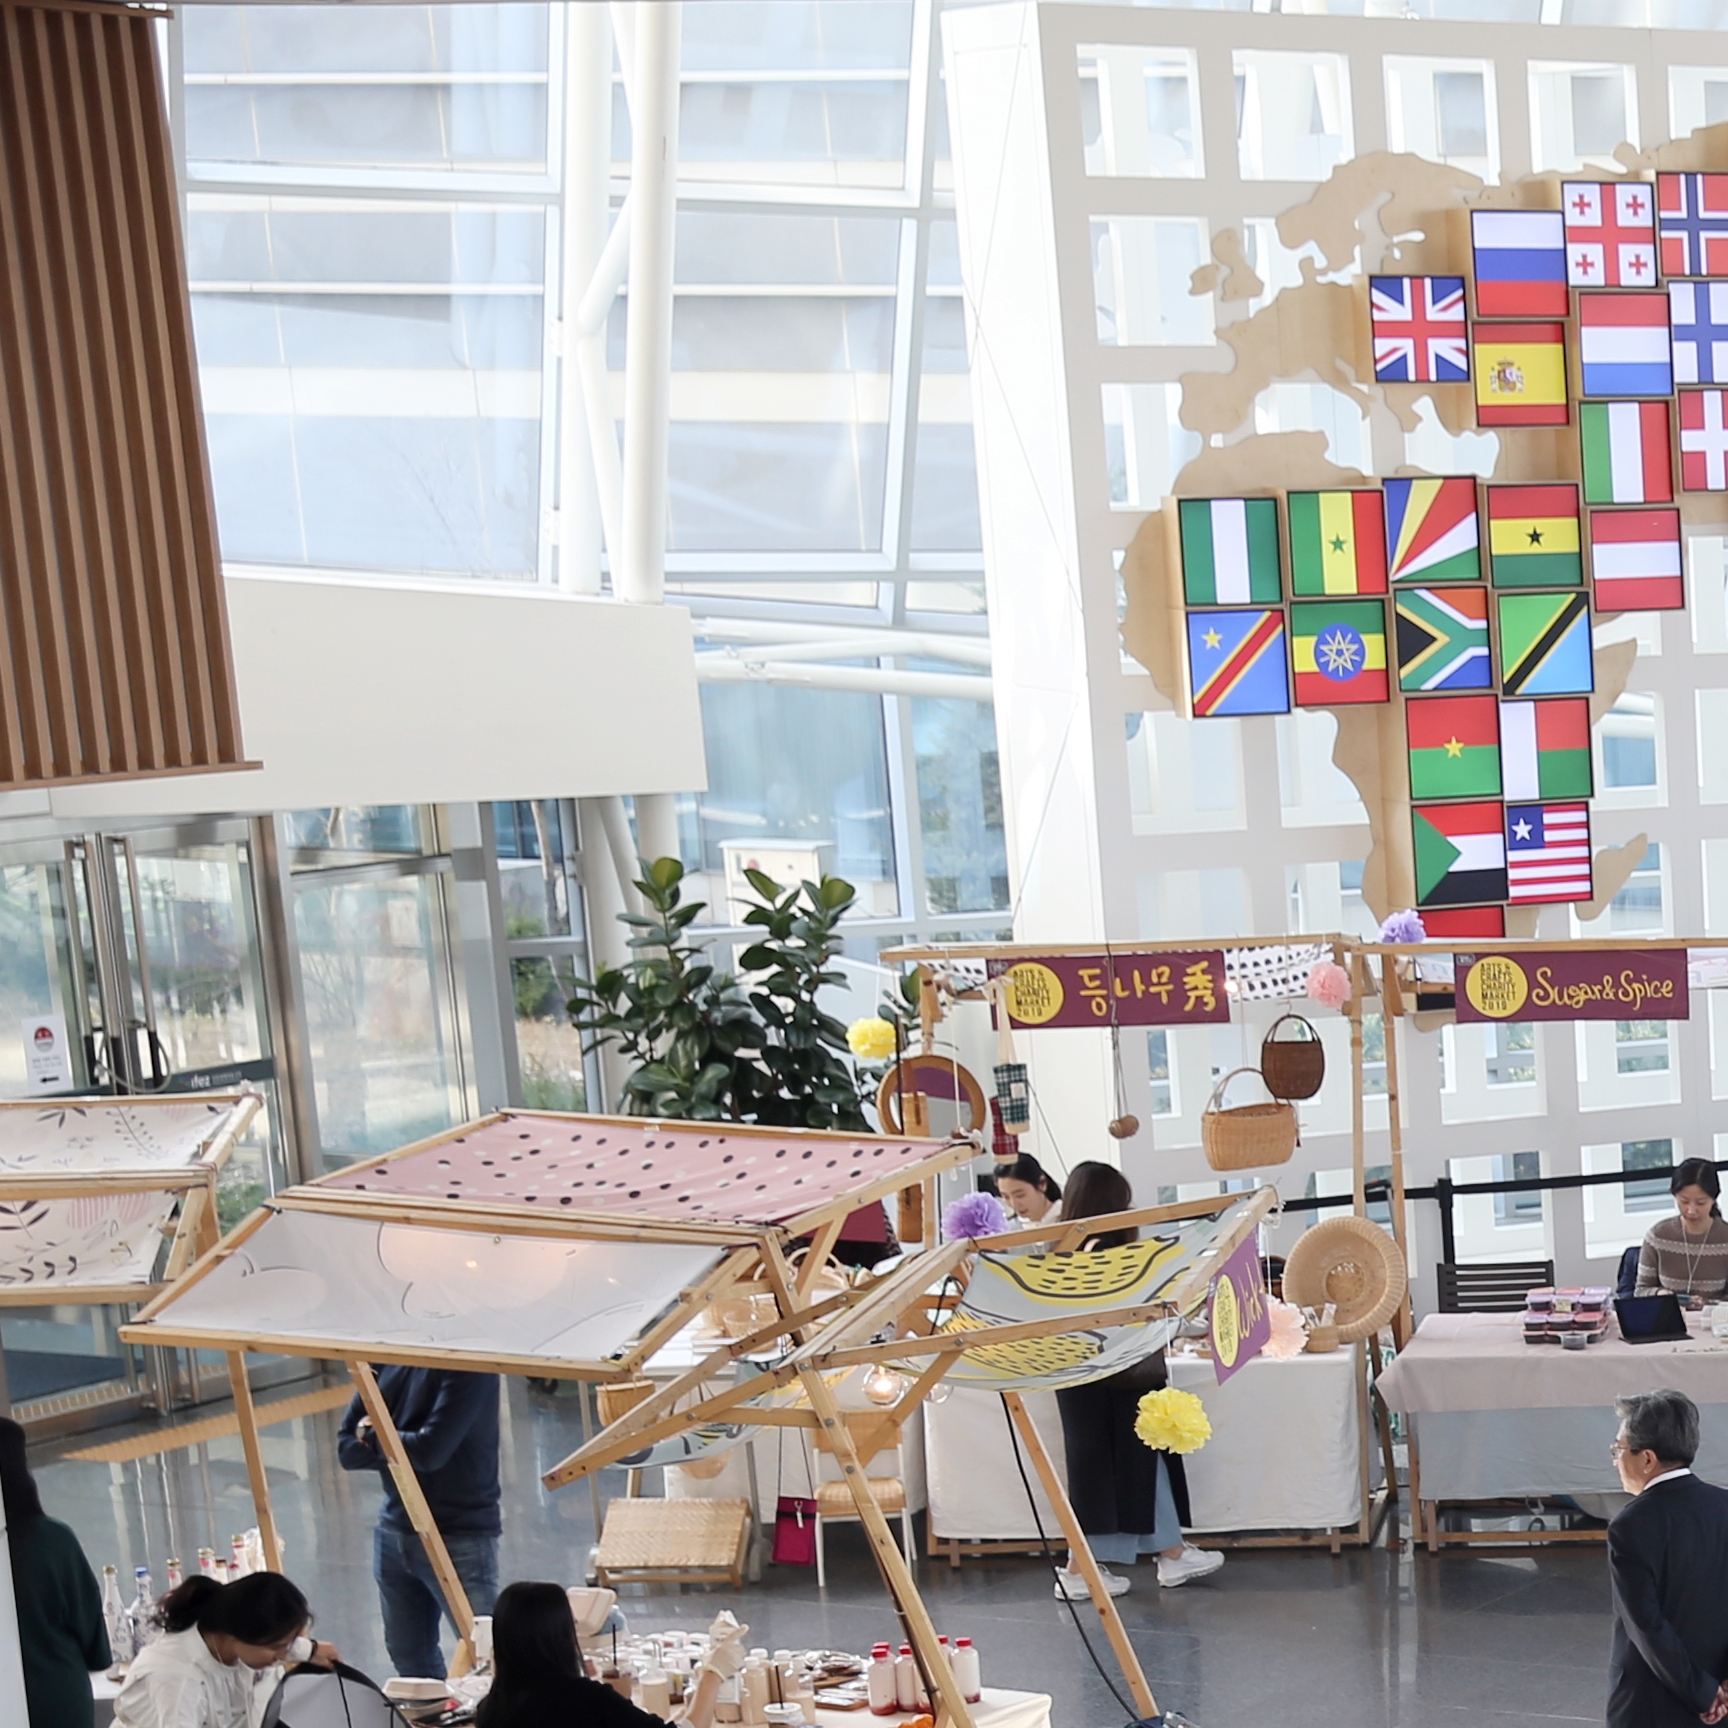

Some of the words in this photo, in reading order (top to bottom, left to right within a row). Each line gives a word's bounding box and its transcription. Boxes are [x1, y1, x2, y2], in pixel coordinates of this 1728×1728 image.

[1480, 962, 1501, 975] ARTS
[1480, 972, 1513, 984] CRAFTS
[1078, 965, 1174, 1016] 등나무
[1182, 960, 1217, 1012] 秀
[1481, 981, 1516, 993] CHARITY
[1015, 996, 1052, 1008] MARKET
[1481, 990, 1517, 1002] MARKET
[1016, 1006, 1043, 1017] 2019
[1481, 1000, 1508, 1011] 2019
